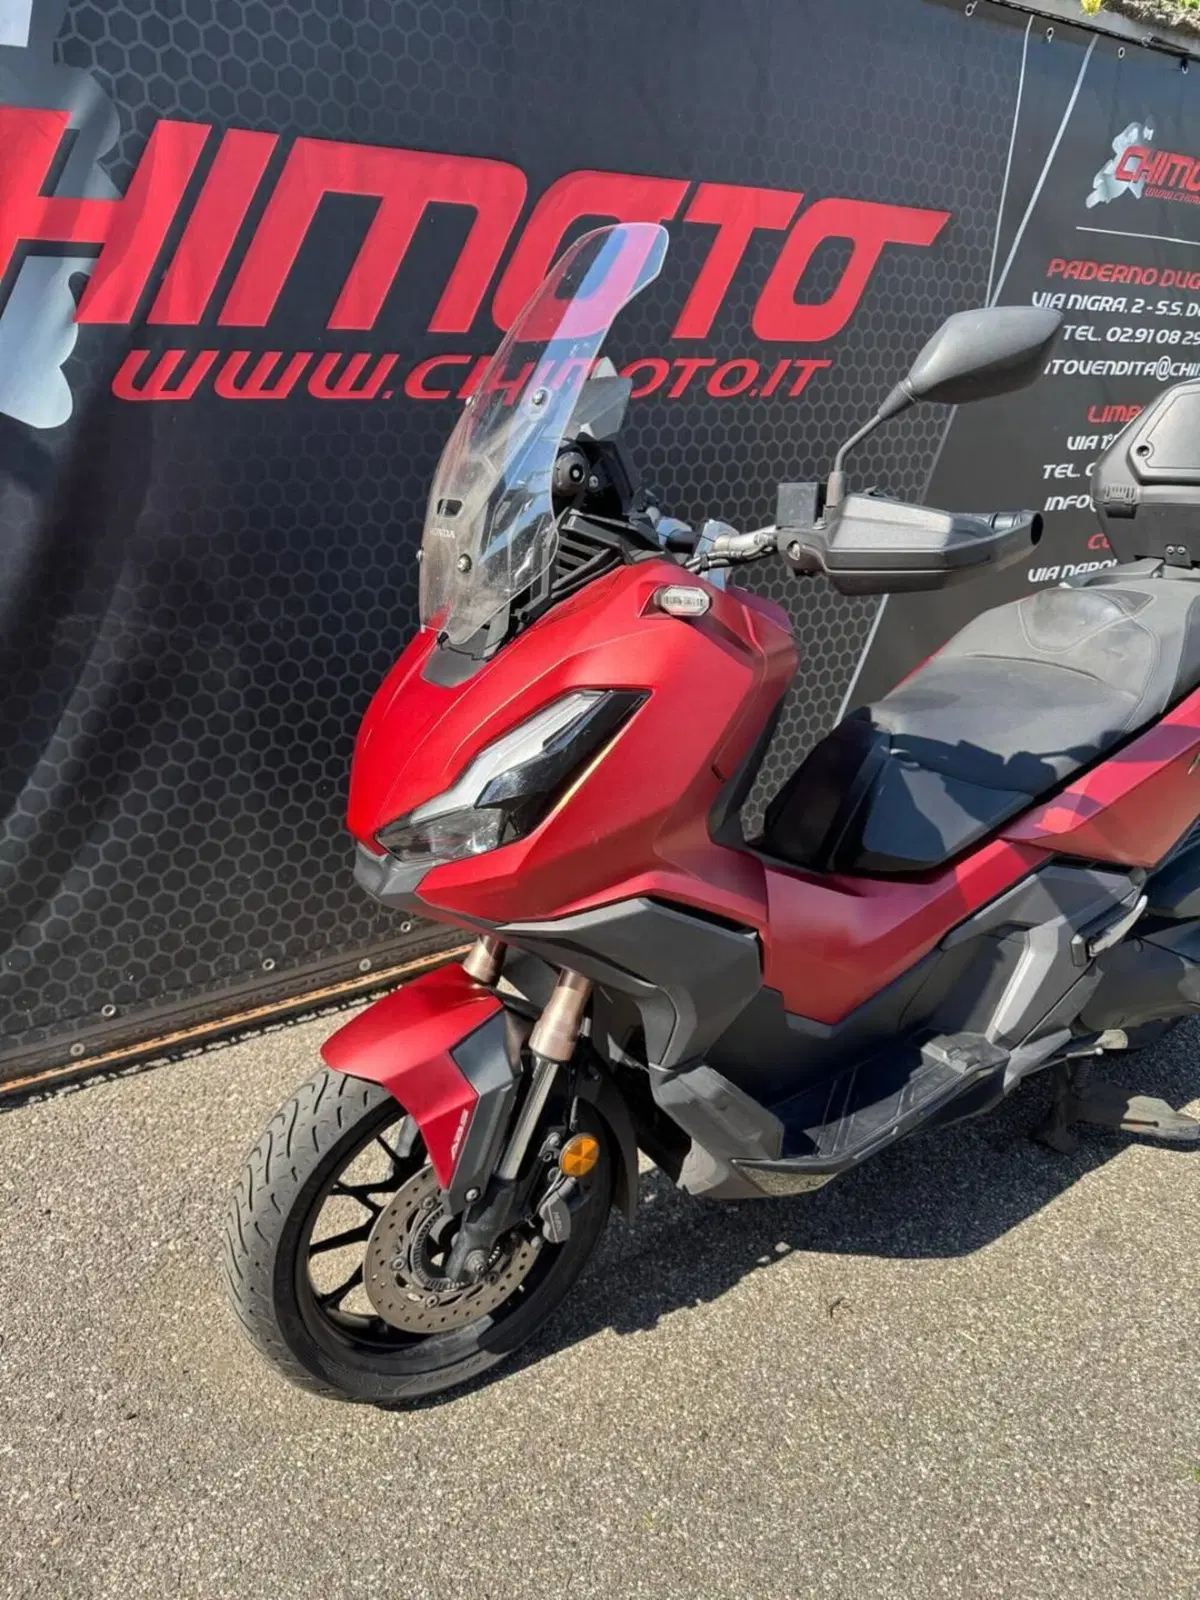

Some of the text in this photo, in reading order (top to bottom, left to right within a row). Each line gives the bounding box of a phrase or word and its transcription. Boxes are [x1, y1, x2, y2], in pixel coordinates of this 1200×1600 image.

[0, 107, 949, 342] HIMOTO
[1047, 258, 1158, 286] PADERNO
[1032, 291, 1066, 309] VIA
[1067, 294, 1128, 314] NIGRA,
[1131, 298, 1145, 313] 2
[1063, 325, 1101, 341] TEL.
[1067, 434, 1099, 450] VIA
[1042, 463, 1080, 479] TEL.
[1027, 566, 1060, 582] VIA
[451, 1108, 469, 1161] ABS
